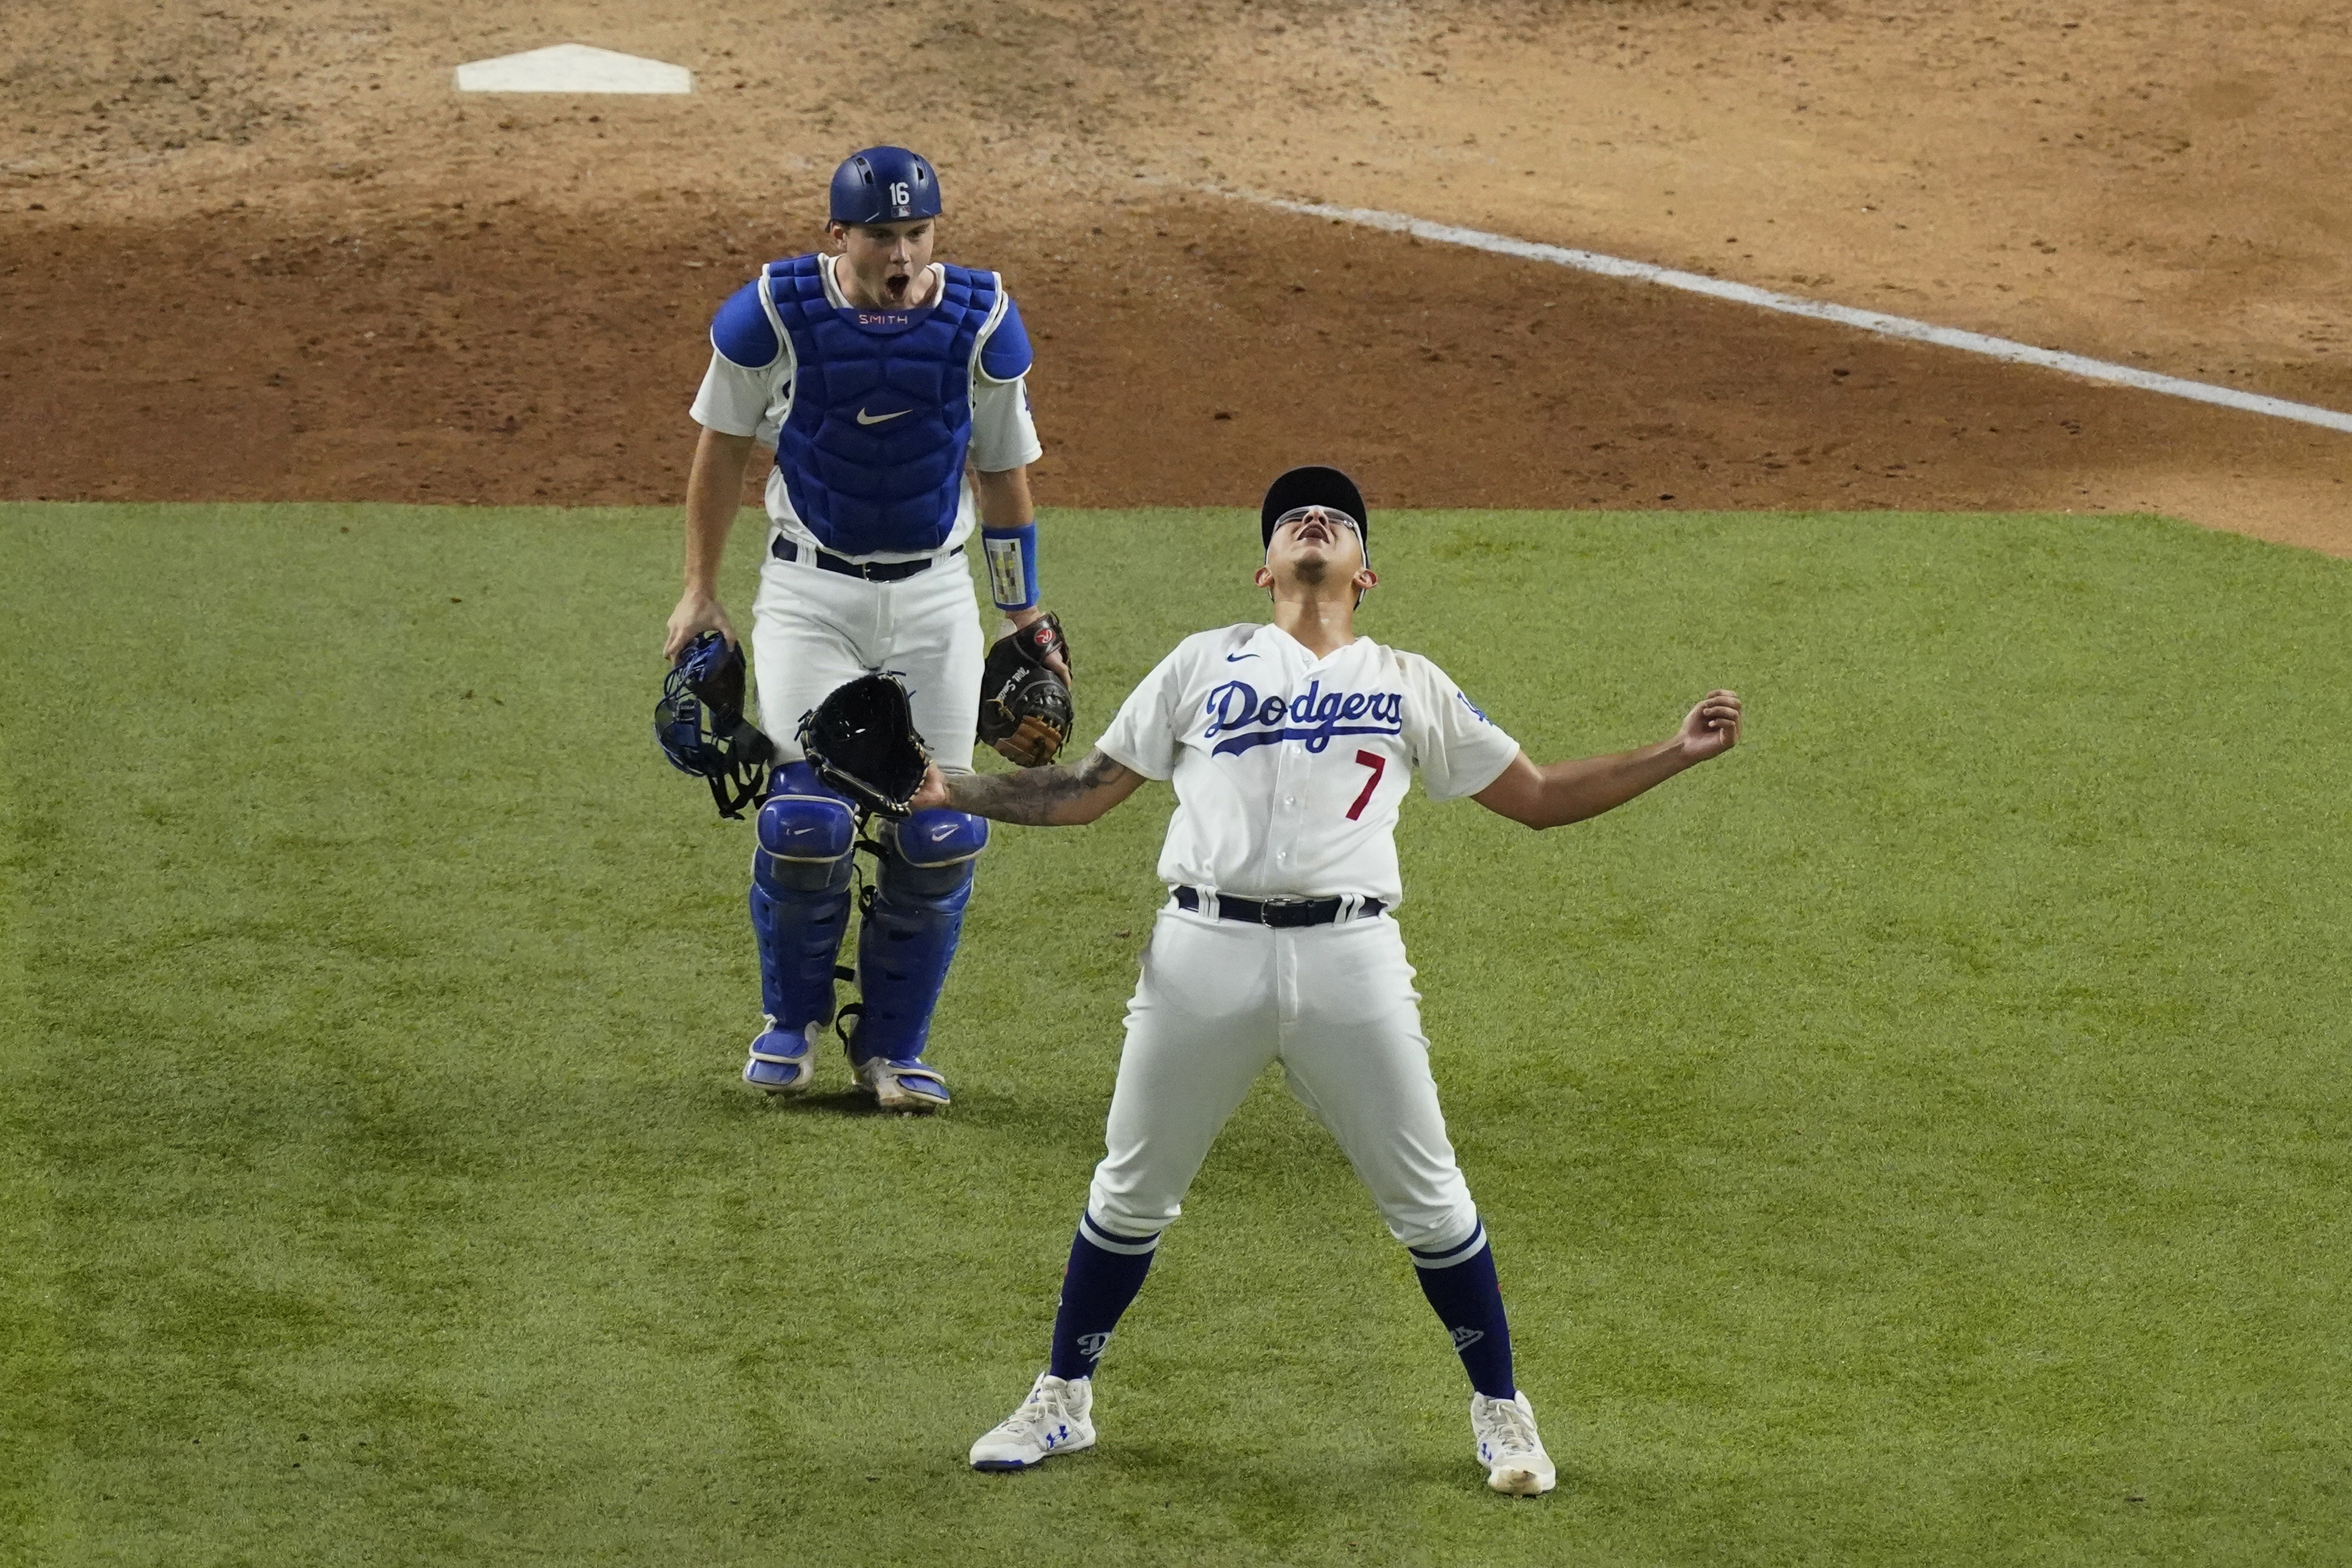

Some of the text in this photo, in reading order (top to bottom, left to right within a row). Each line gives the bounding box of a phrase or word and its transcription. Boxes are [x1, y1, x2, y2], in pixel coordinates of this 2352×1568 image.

[889, 182, 910, 206] 16
[859, 314, 908, 324] SMITH
[1012, 666, 1030, 682] Will
[1204, 680, 1403, 755] Dodgers
[1345, 749, 1386, 821] 7
